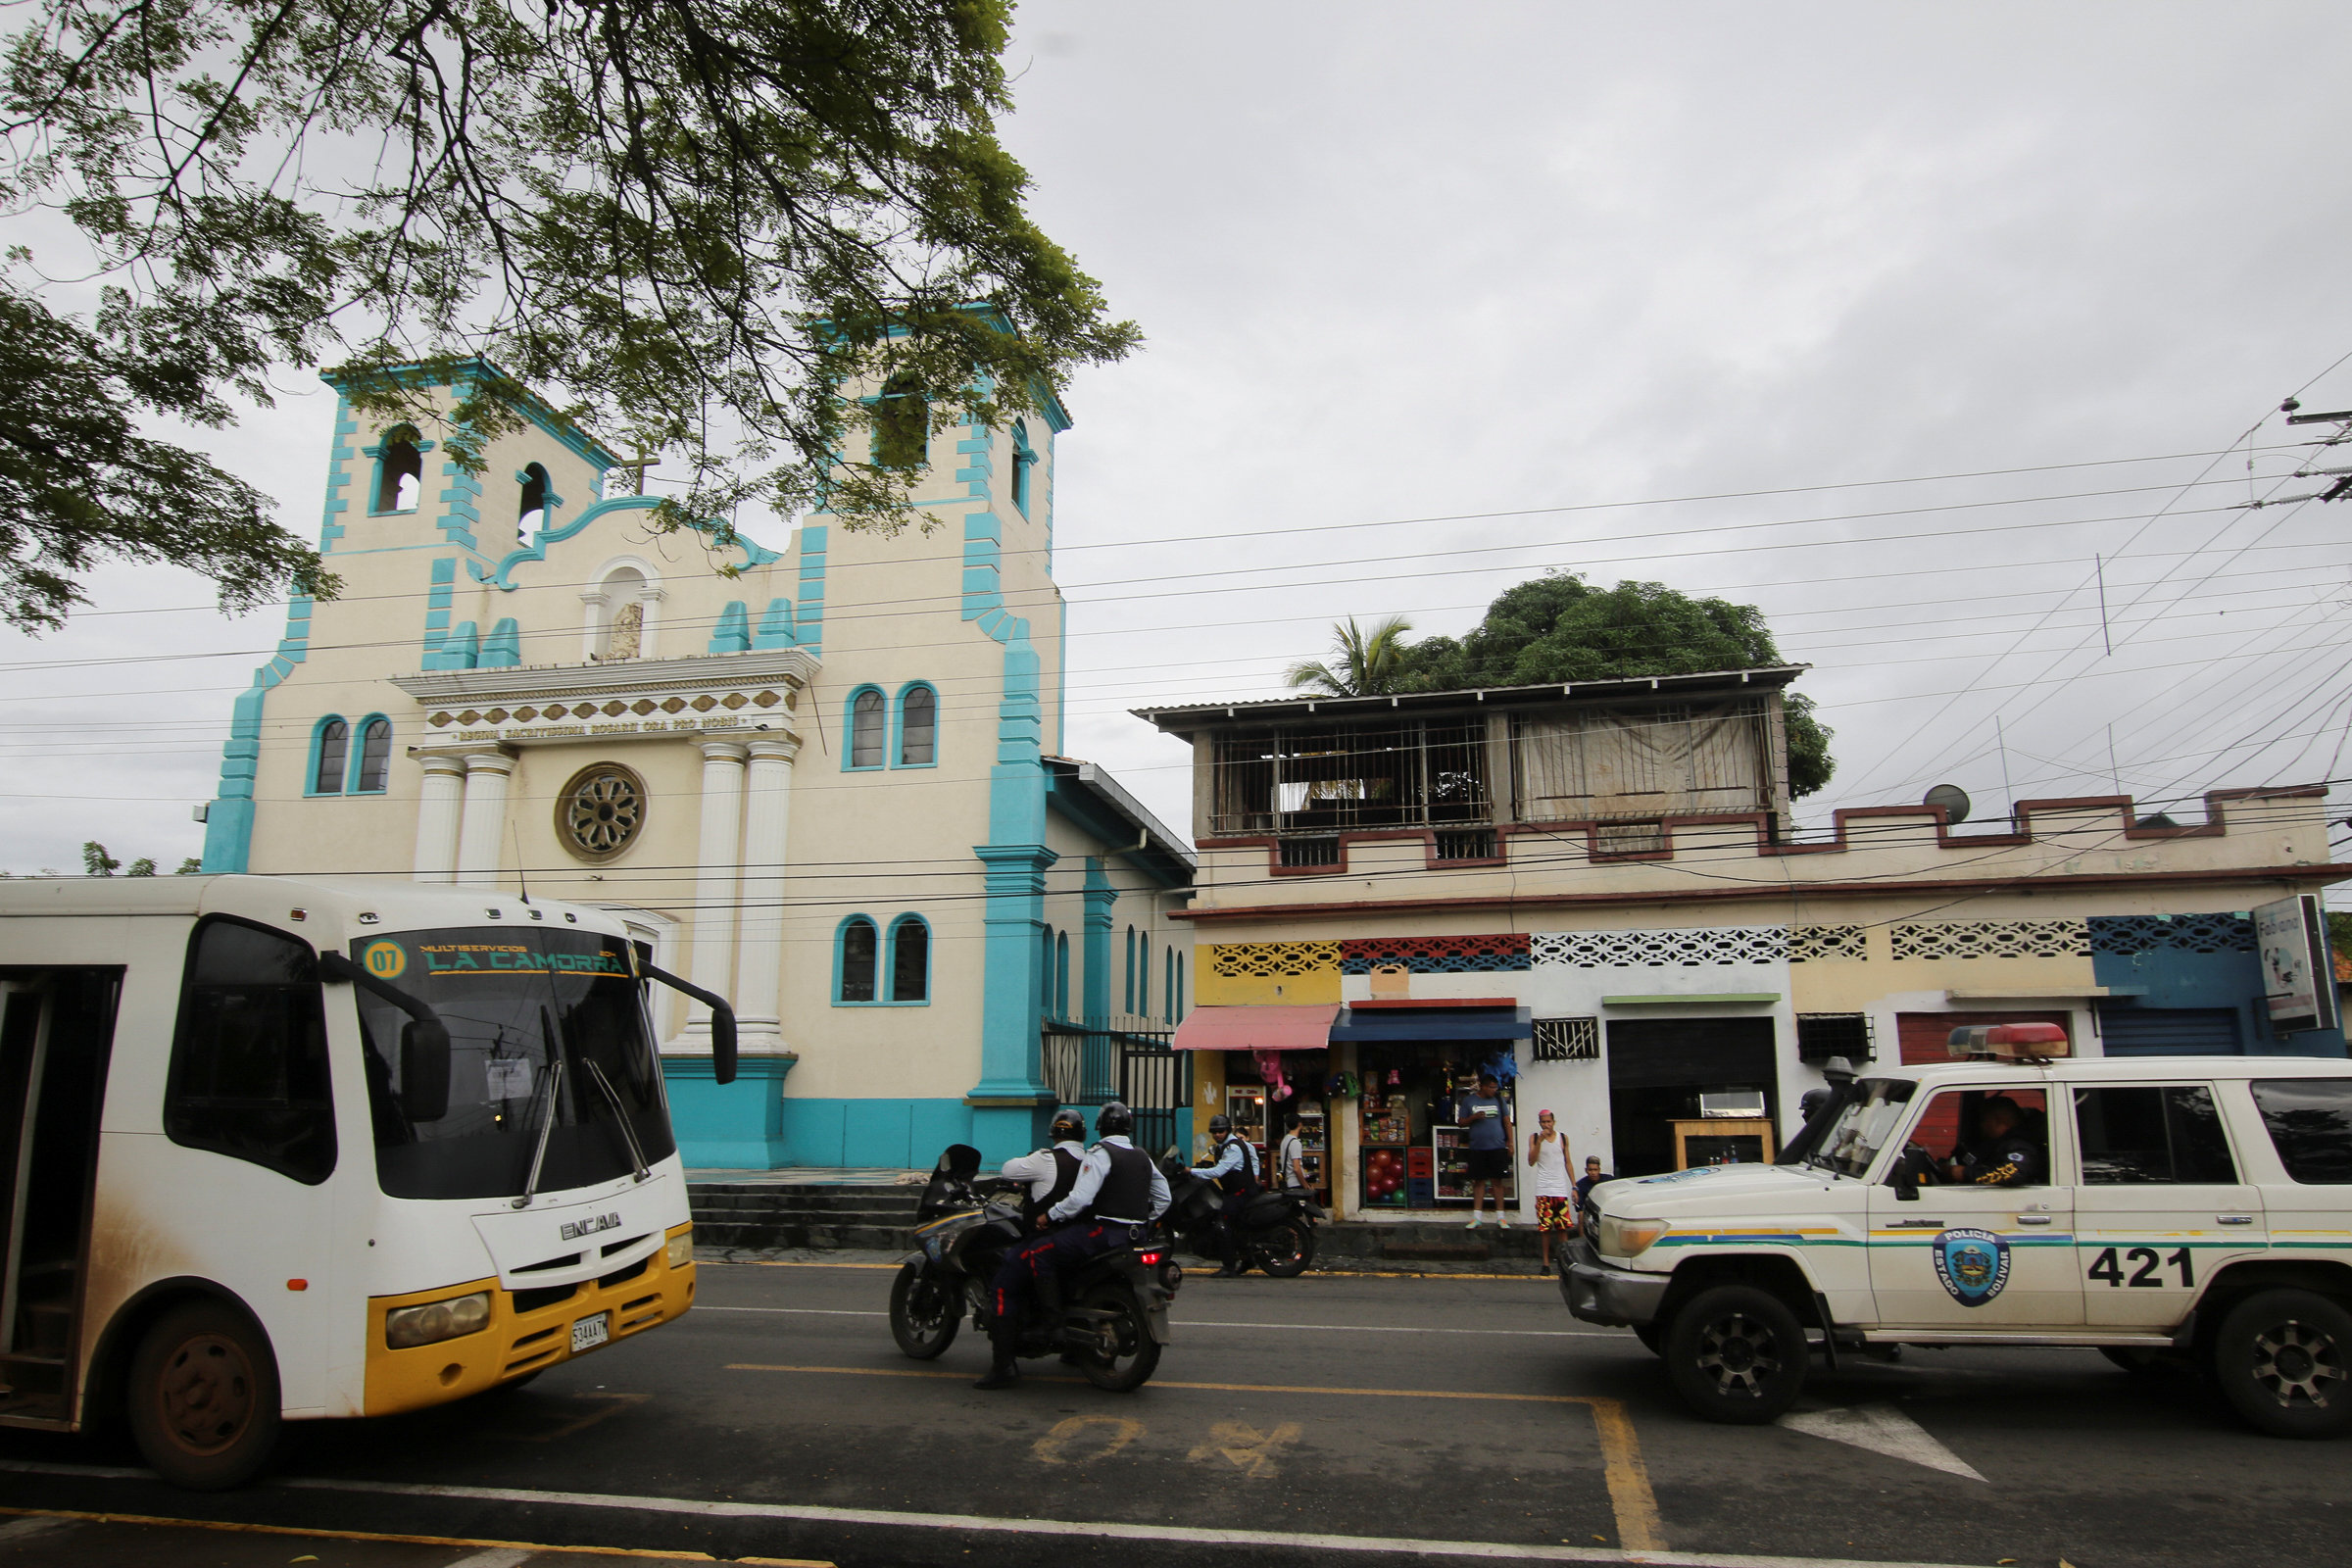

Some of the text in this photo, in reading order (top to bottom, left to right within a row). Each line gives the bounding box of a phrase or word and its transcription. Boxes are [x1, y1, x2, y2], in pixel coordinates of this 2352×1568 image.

[459, 730, 501, 742] REGINA
[643, 720, 667, 731] ORA
[673, 719, 696, 730] PRO
[702, 715, 739, 729] NOBIS
[2259, 917, 2299, 939] Fabana
[372, 950, 397, 971] 07
[424, 952, 625, 973] LA CAMORRA
[561, 1211, 622, 1241] ENCAVA
[1935, 1249, 1960, 1296] ESTADO
[2087, 1247, 2195, 1288] 421
